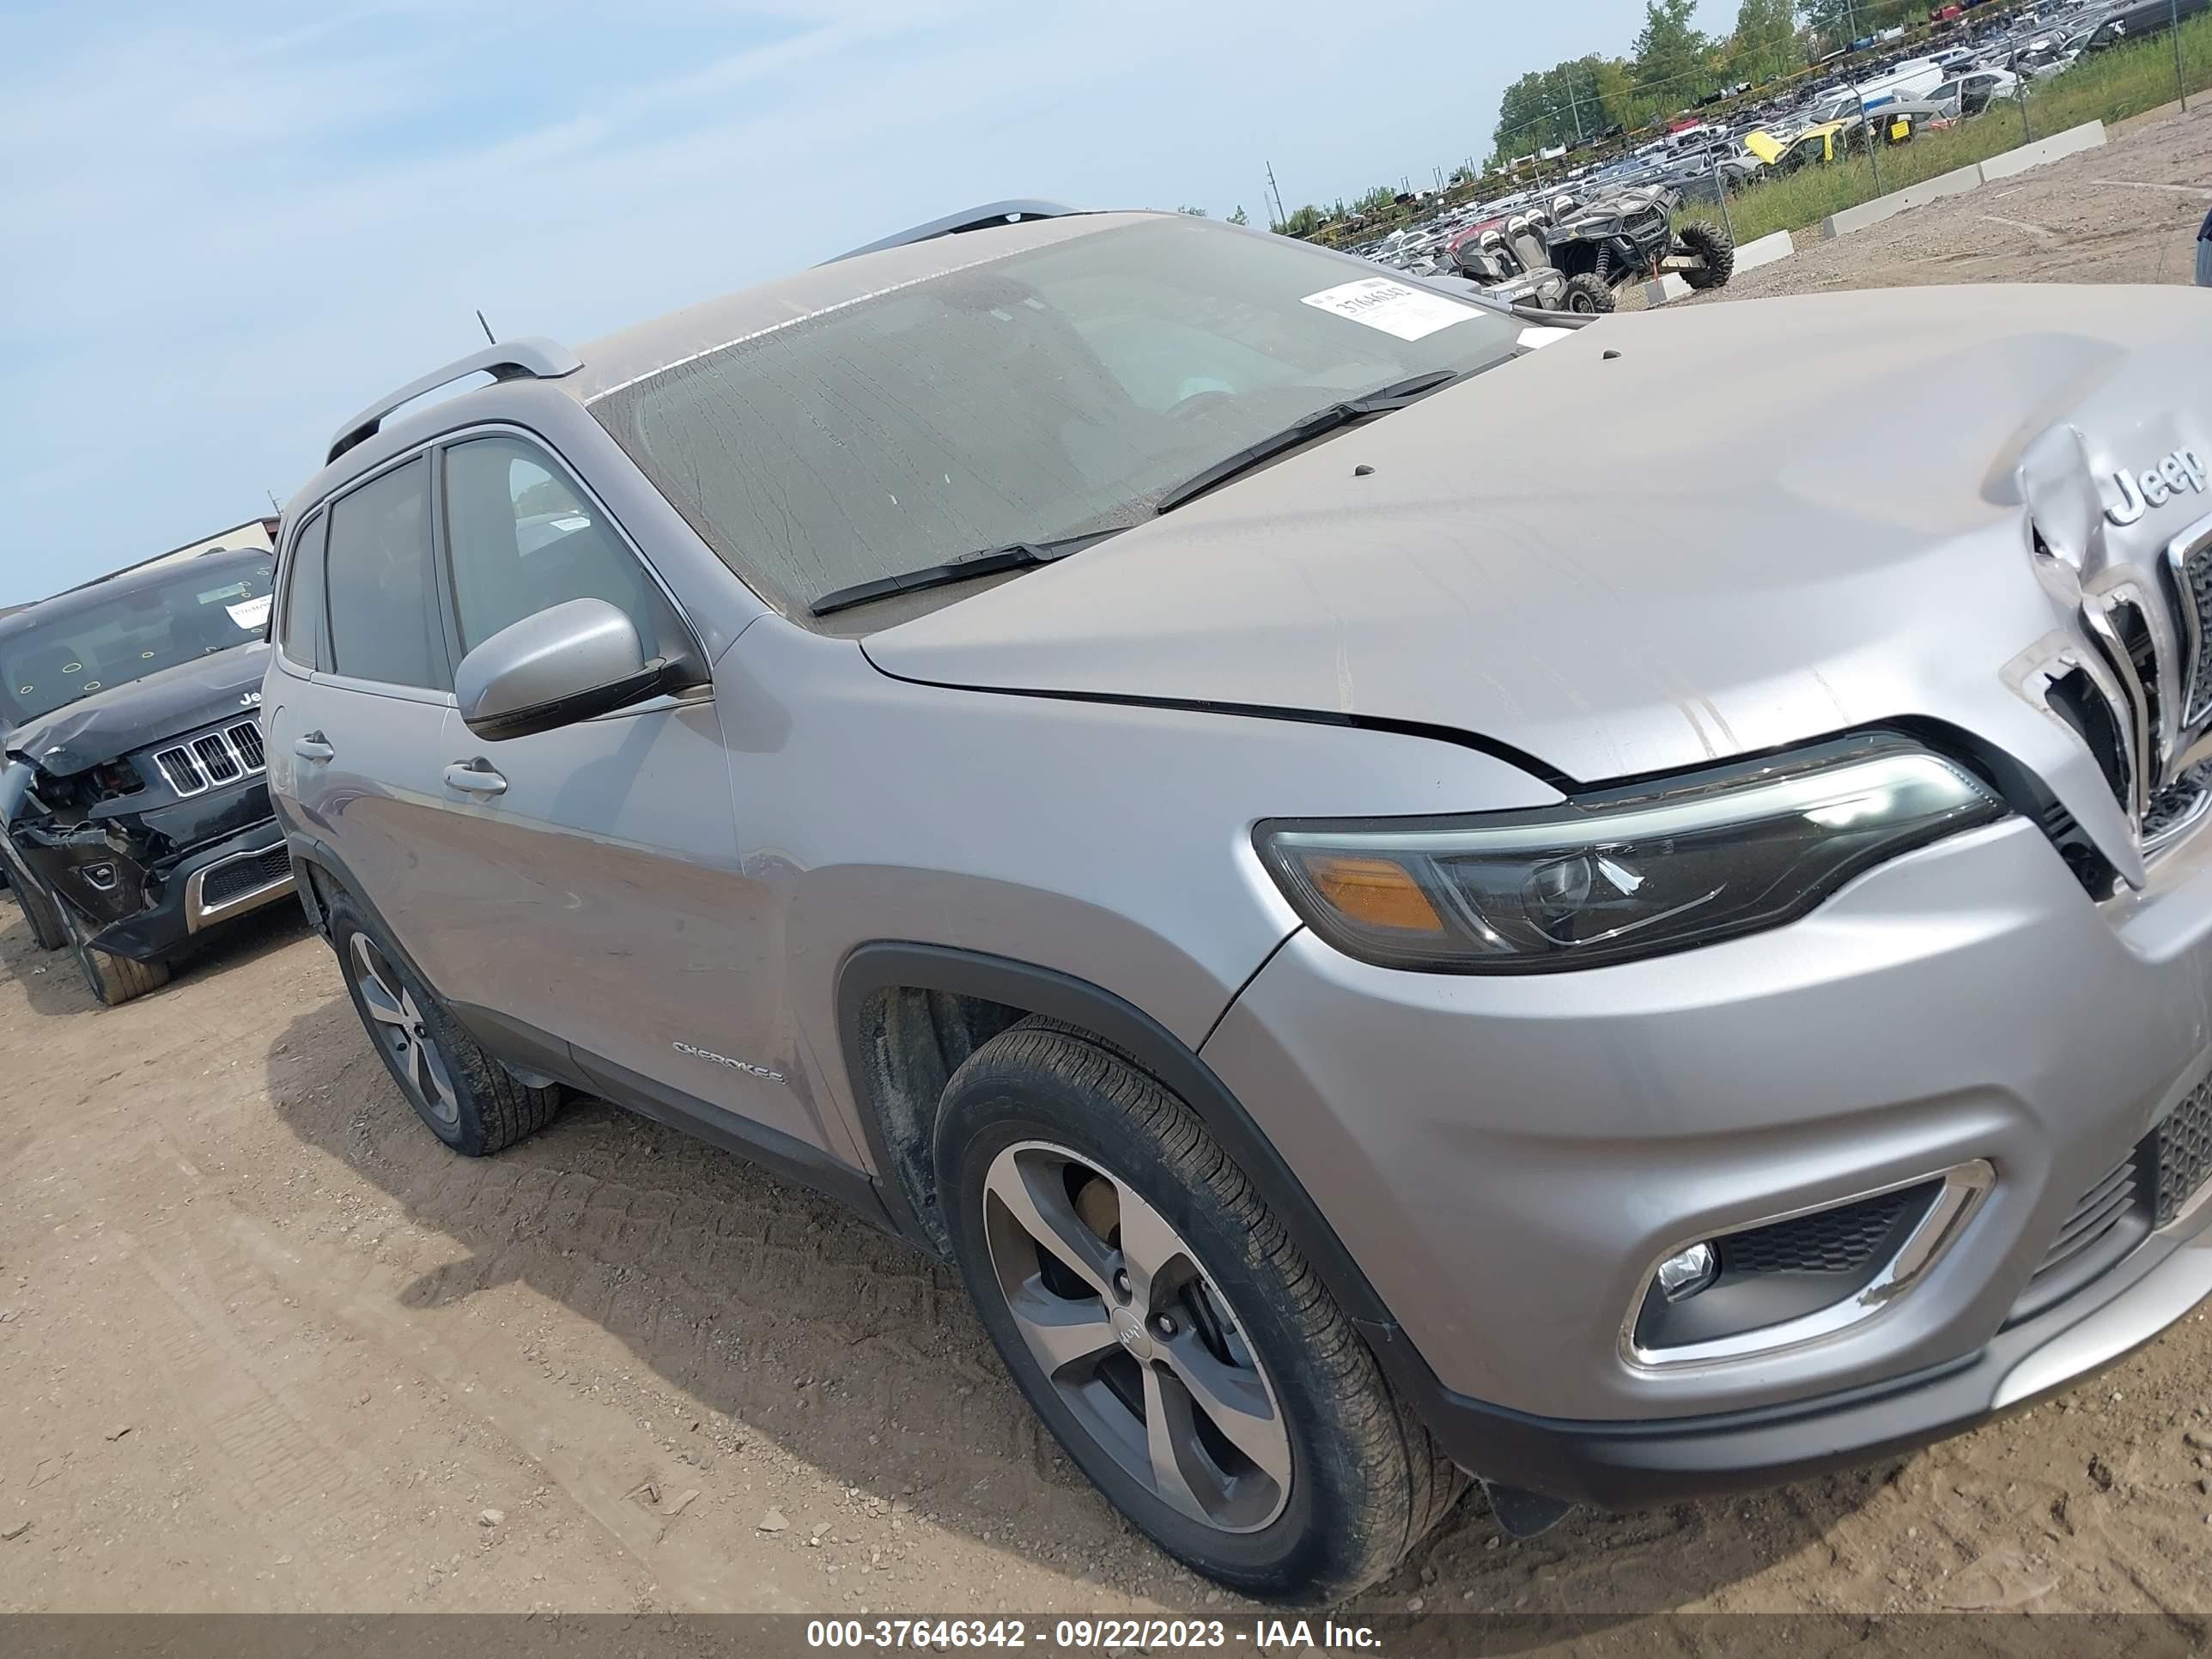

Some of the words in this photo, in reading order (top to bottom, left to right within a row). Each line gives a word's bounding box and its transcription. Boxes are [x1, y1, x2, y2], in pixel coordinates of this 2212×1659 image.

[1335, 287, 1413, 313] 37646342
[2104, 446, 2207, 526] Jeep
[240, 692, 261, 705] Je
[672, 1041, 787, 1085] CHEROKEE
